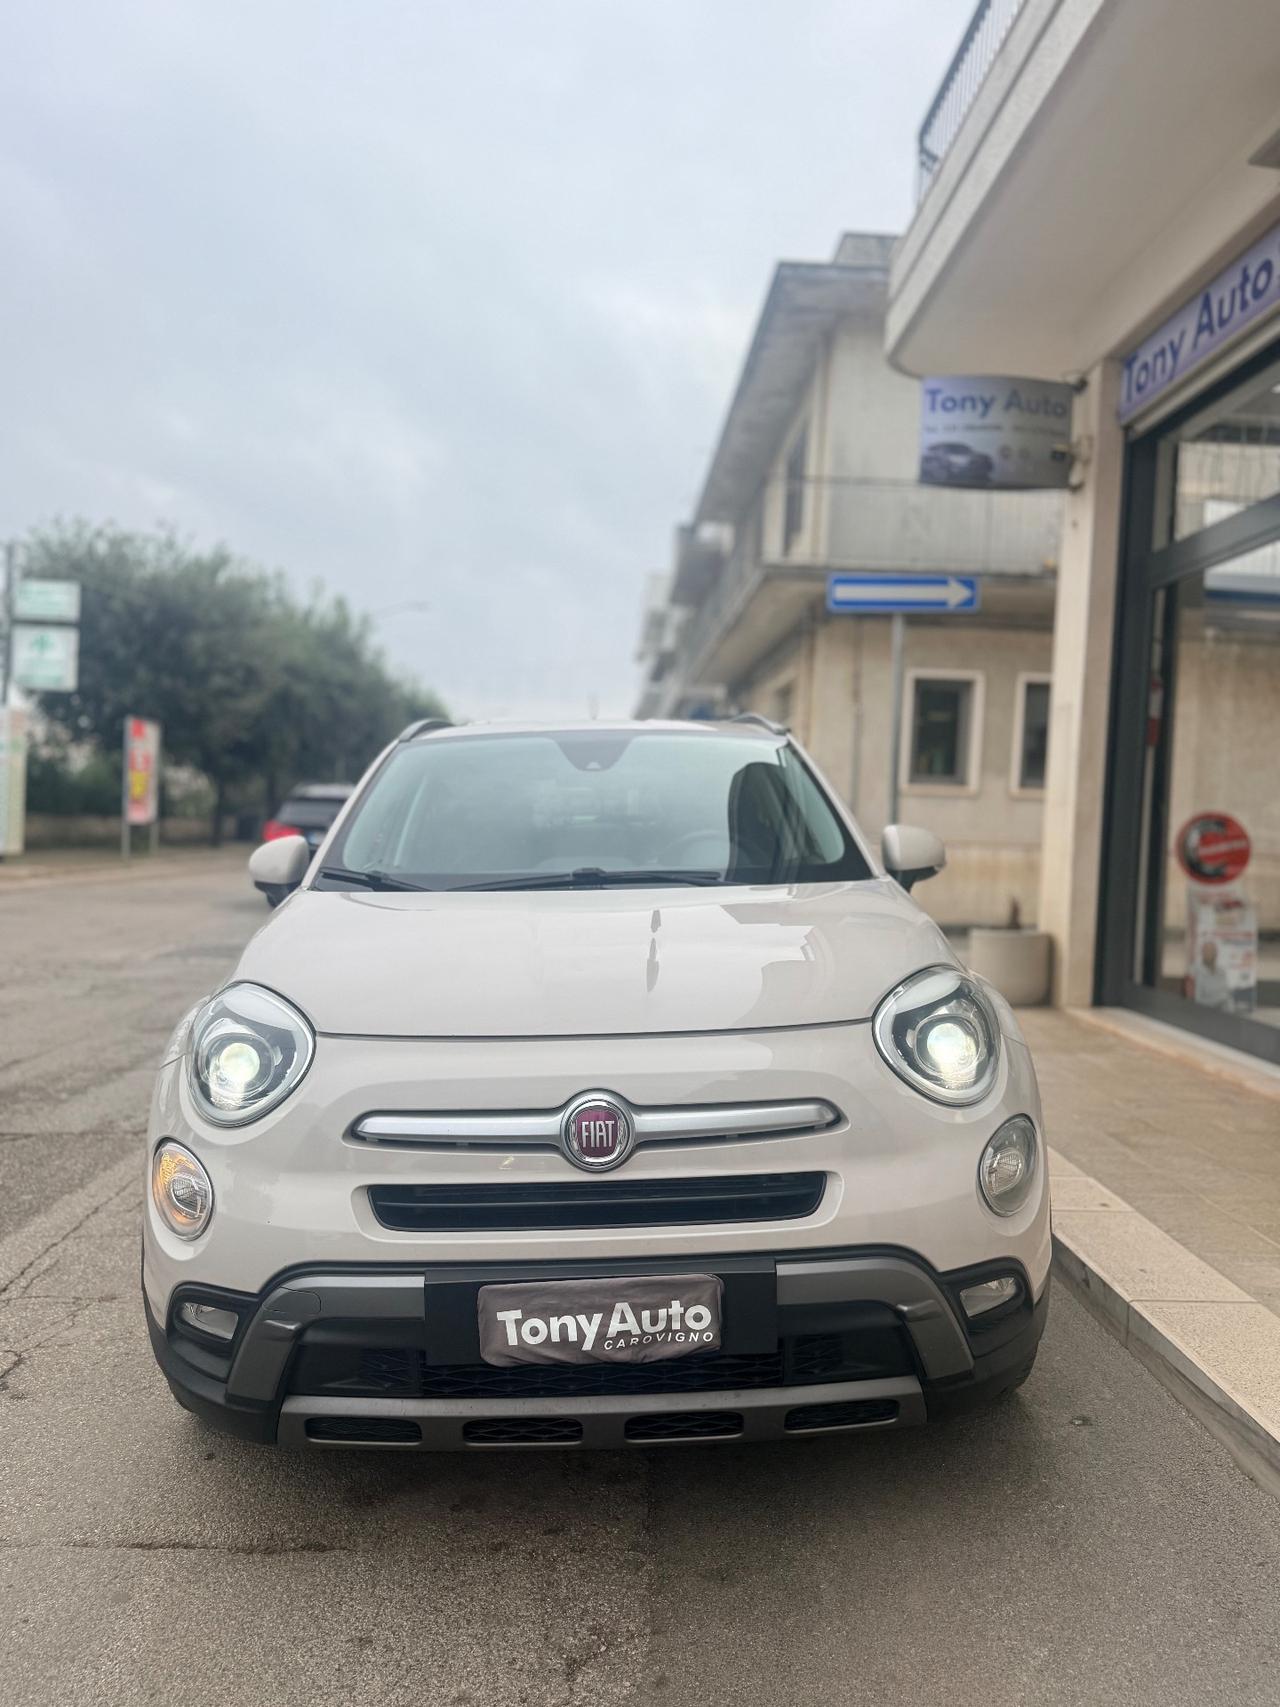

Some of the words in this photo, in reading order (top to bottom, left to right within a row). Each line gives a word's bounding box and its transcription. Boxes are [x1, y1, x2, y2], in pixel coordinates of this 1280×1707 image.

[1123, 327, 1186, 403] Tony
[1193, 258, 1273, 350] Auto
[925, 387, 996, 418] Tony
[1004, 388, 1067, 418] Auto
[581, 1120, 615, 1148] FIAT
[604, 1331, 714, 1350] CAROVIGNO
